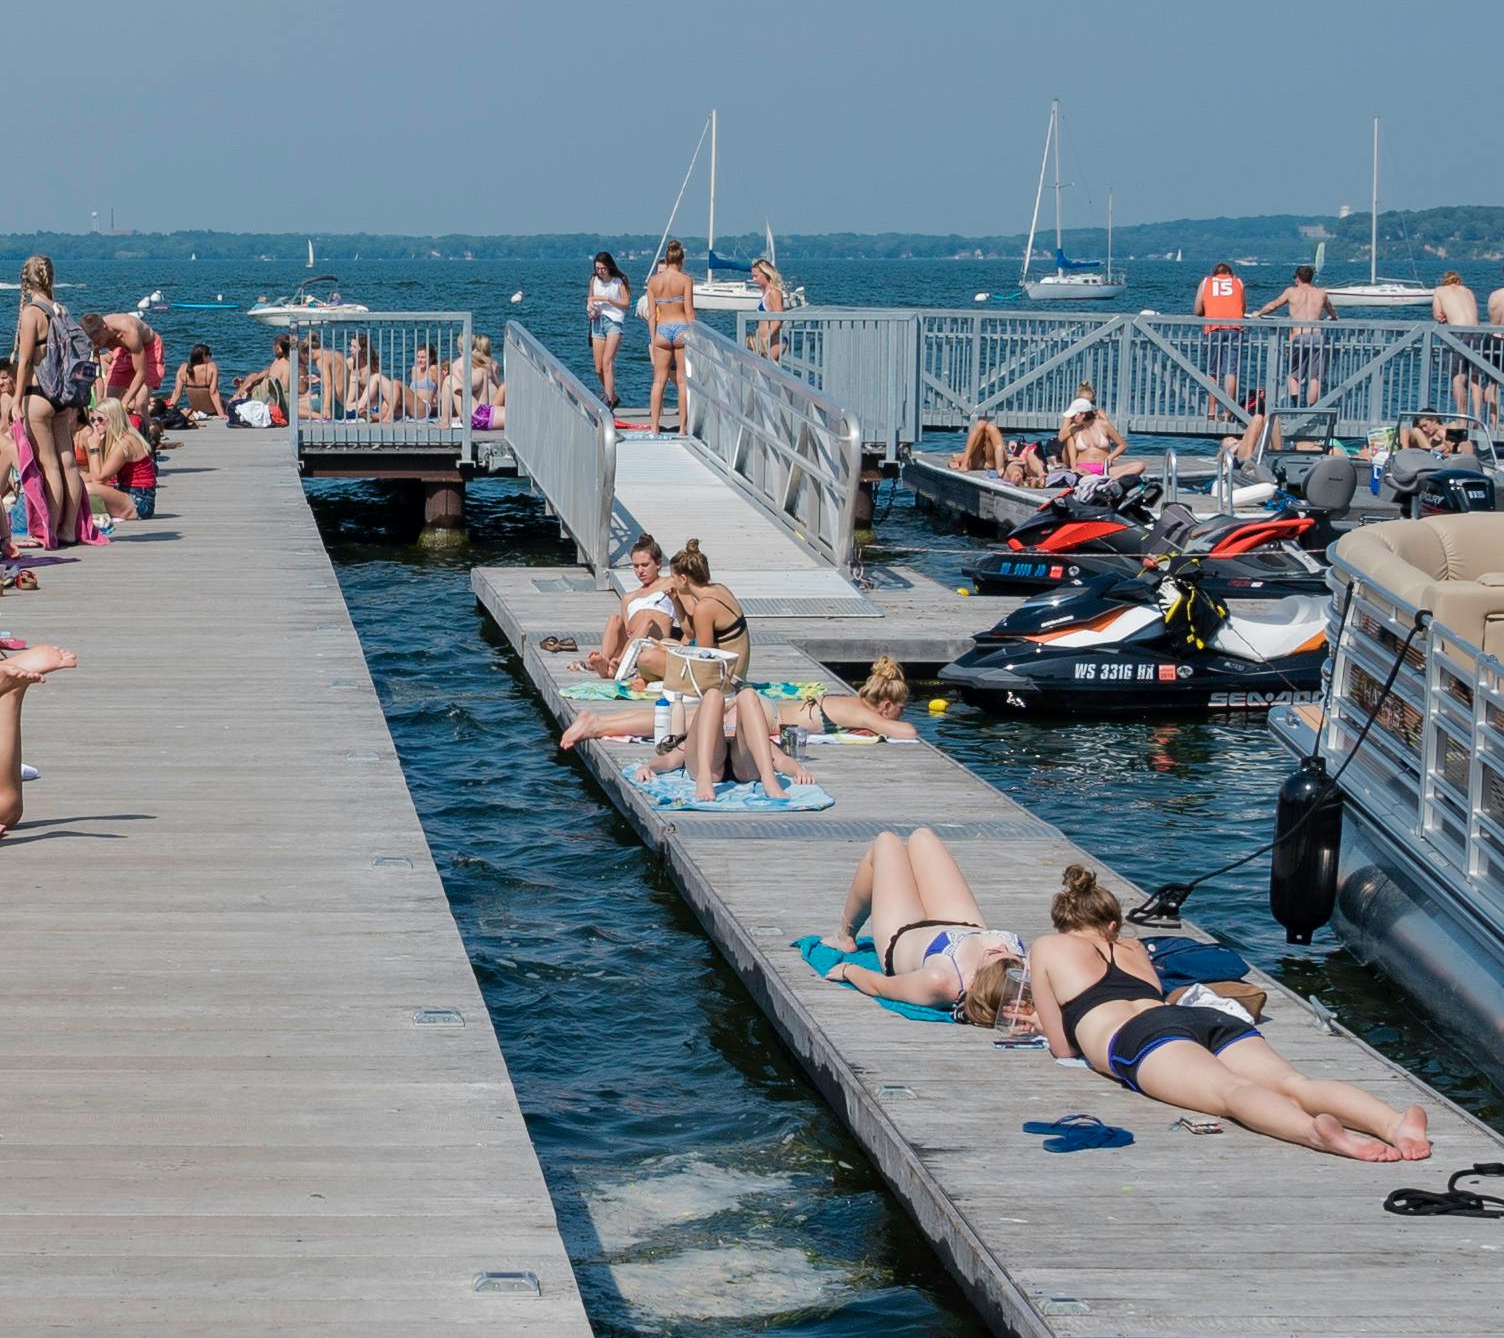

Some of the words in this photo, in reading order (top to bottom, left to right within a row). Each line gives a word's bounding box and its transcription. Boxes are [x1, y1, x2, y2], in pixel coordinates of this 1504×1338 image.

[1212, 276, 1233, 296] 15
[1075, 663, 1096, 680] WS
[1100, 663, 1133, 680] 3316
